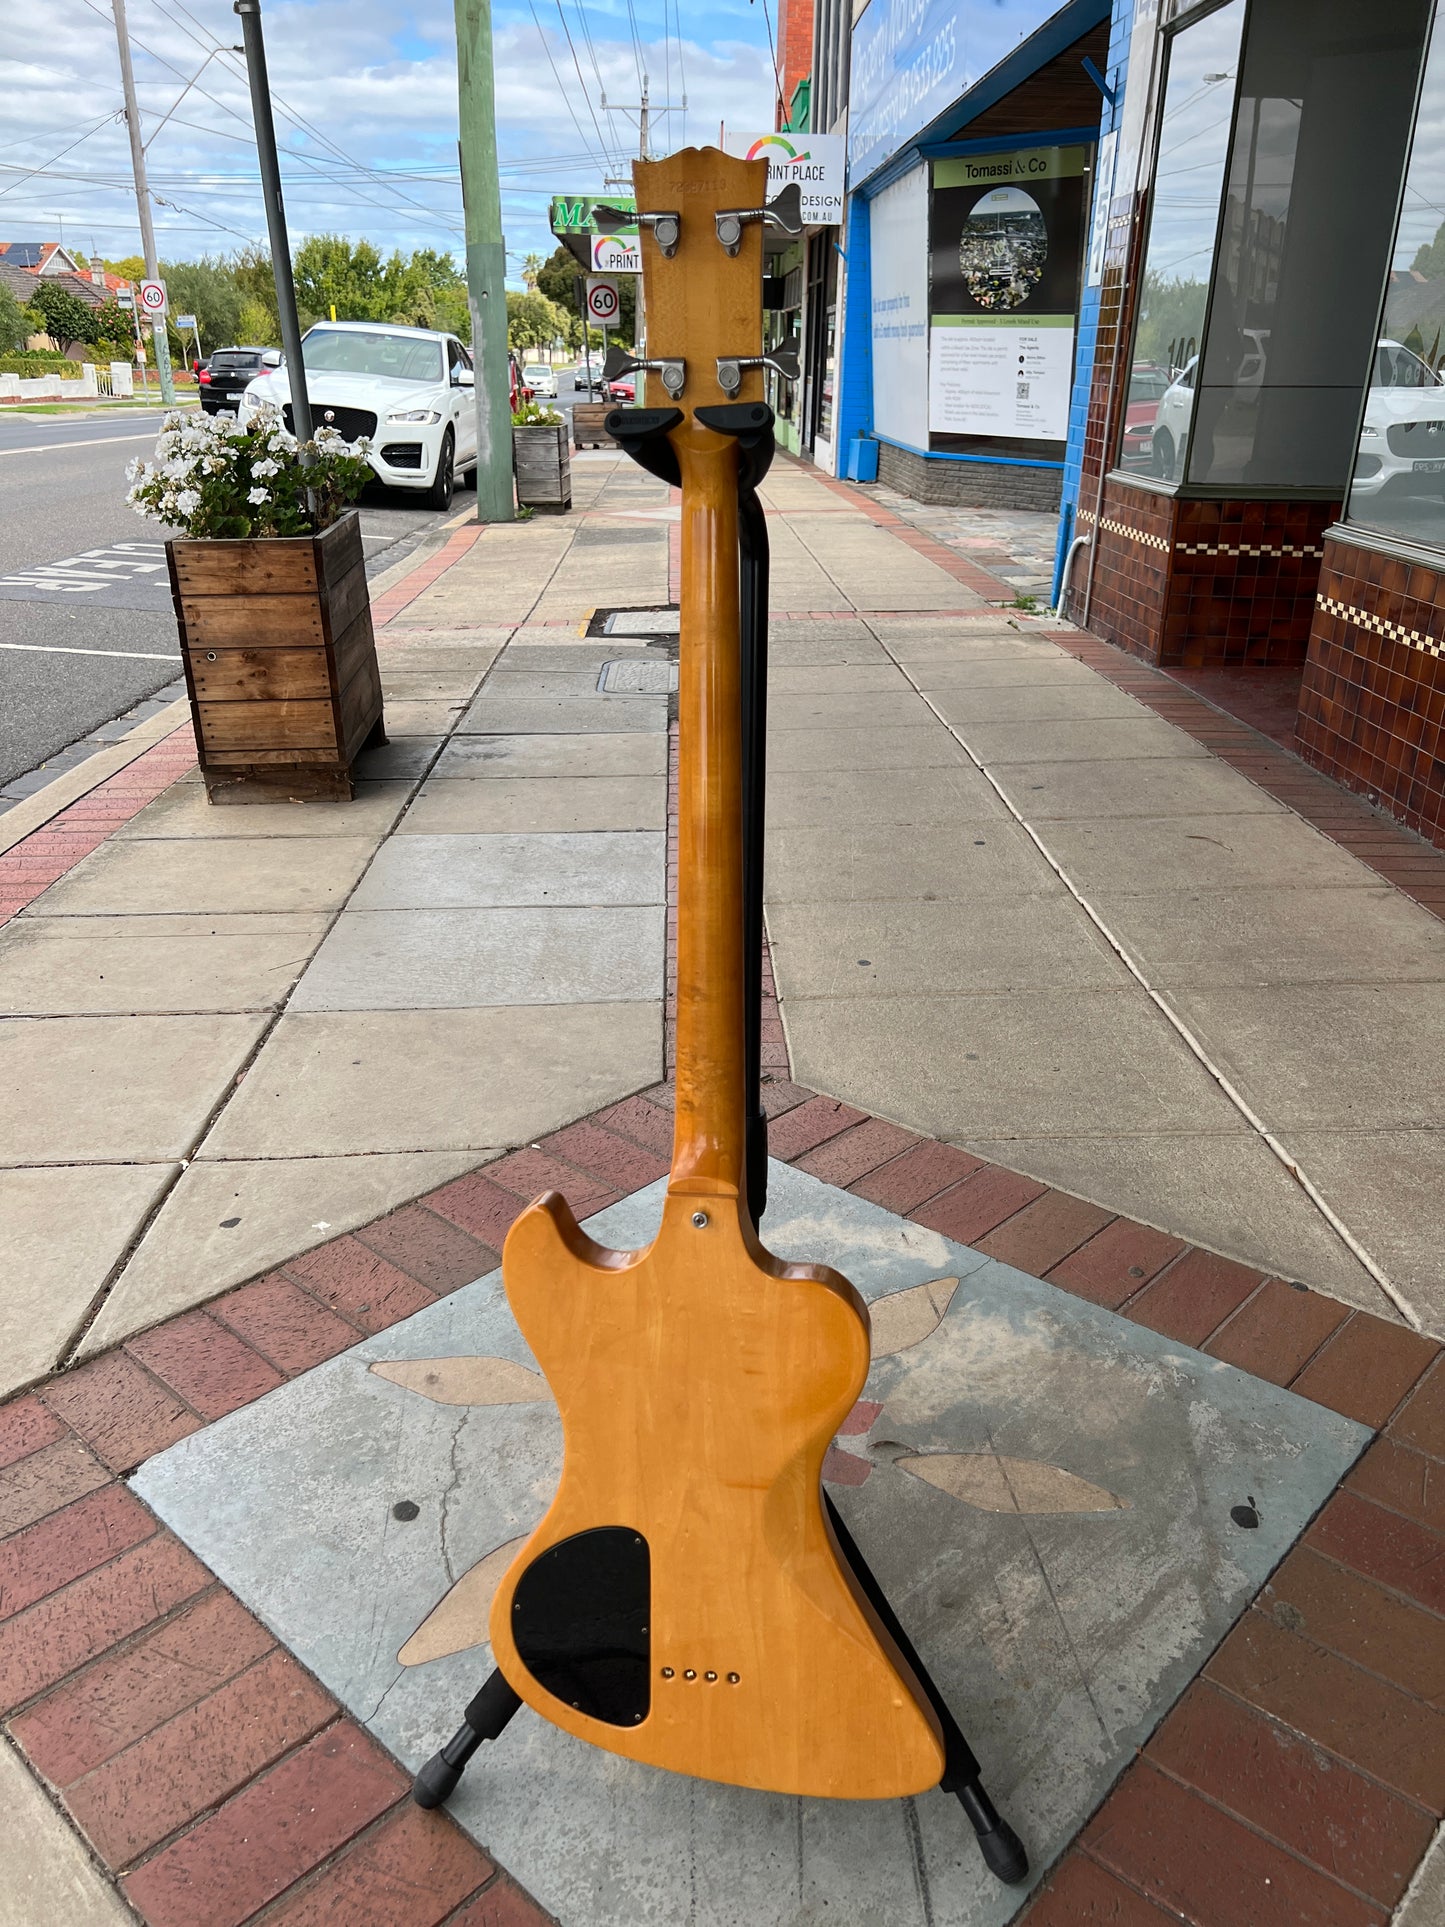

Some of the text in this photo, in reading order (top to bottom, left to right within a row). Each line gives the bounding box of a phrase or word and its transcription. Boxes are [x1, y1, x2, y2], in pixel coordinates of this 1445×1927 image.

[767, 165, 826, 181] RINT PLACE
[965, 160, 1013, 179] Tomassi
[1028, 158, 1047, 173] Co
[802, 195, 842, 207] DESIGN
[609, 254, 640, 269] PRINT
[146, 291, 161, 303] 60
[593, 293, 614, 309] 60
